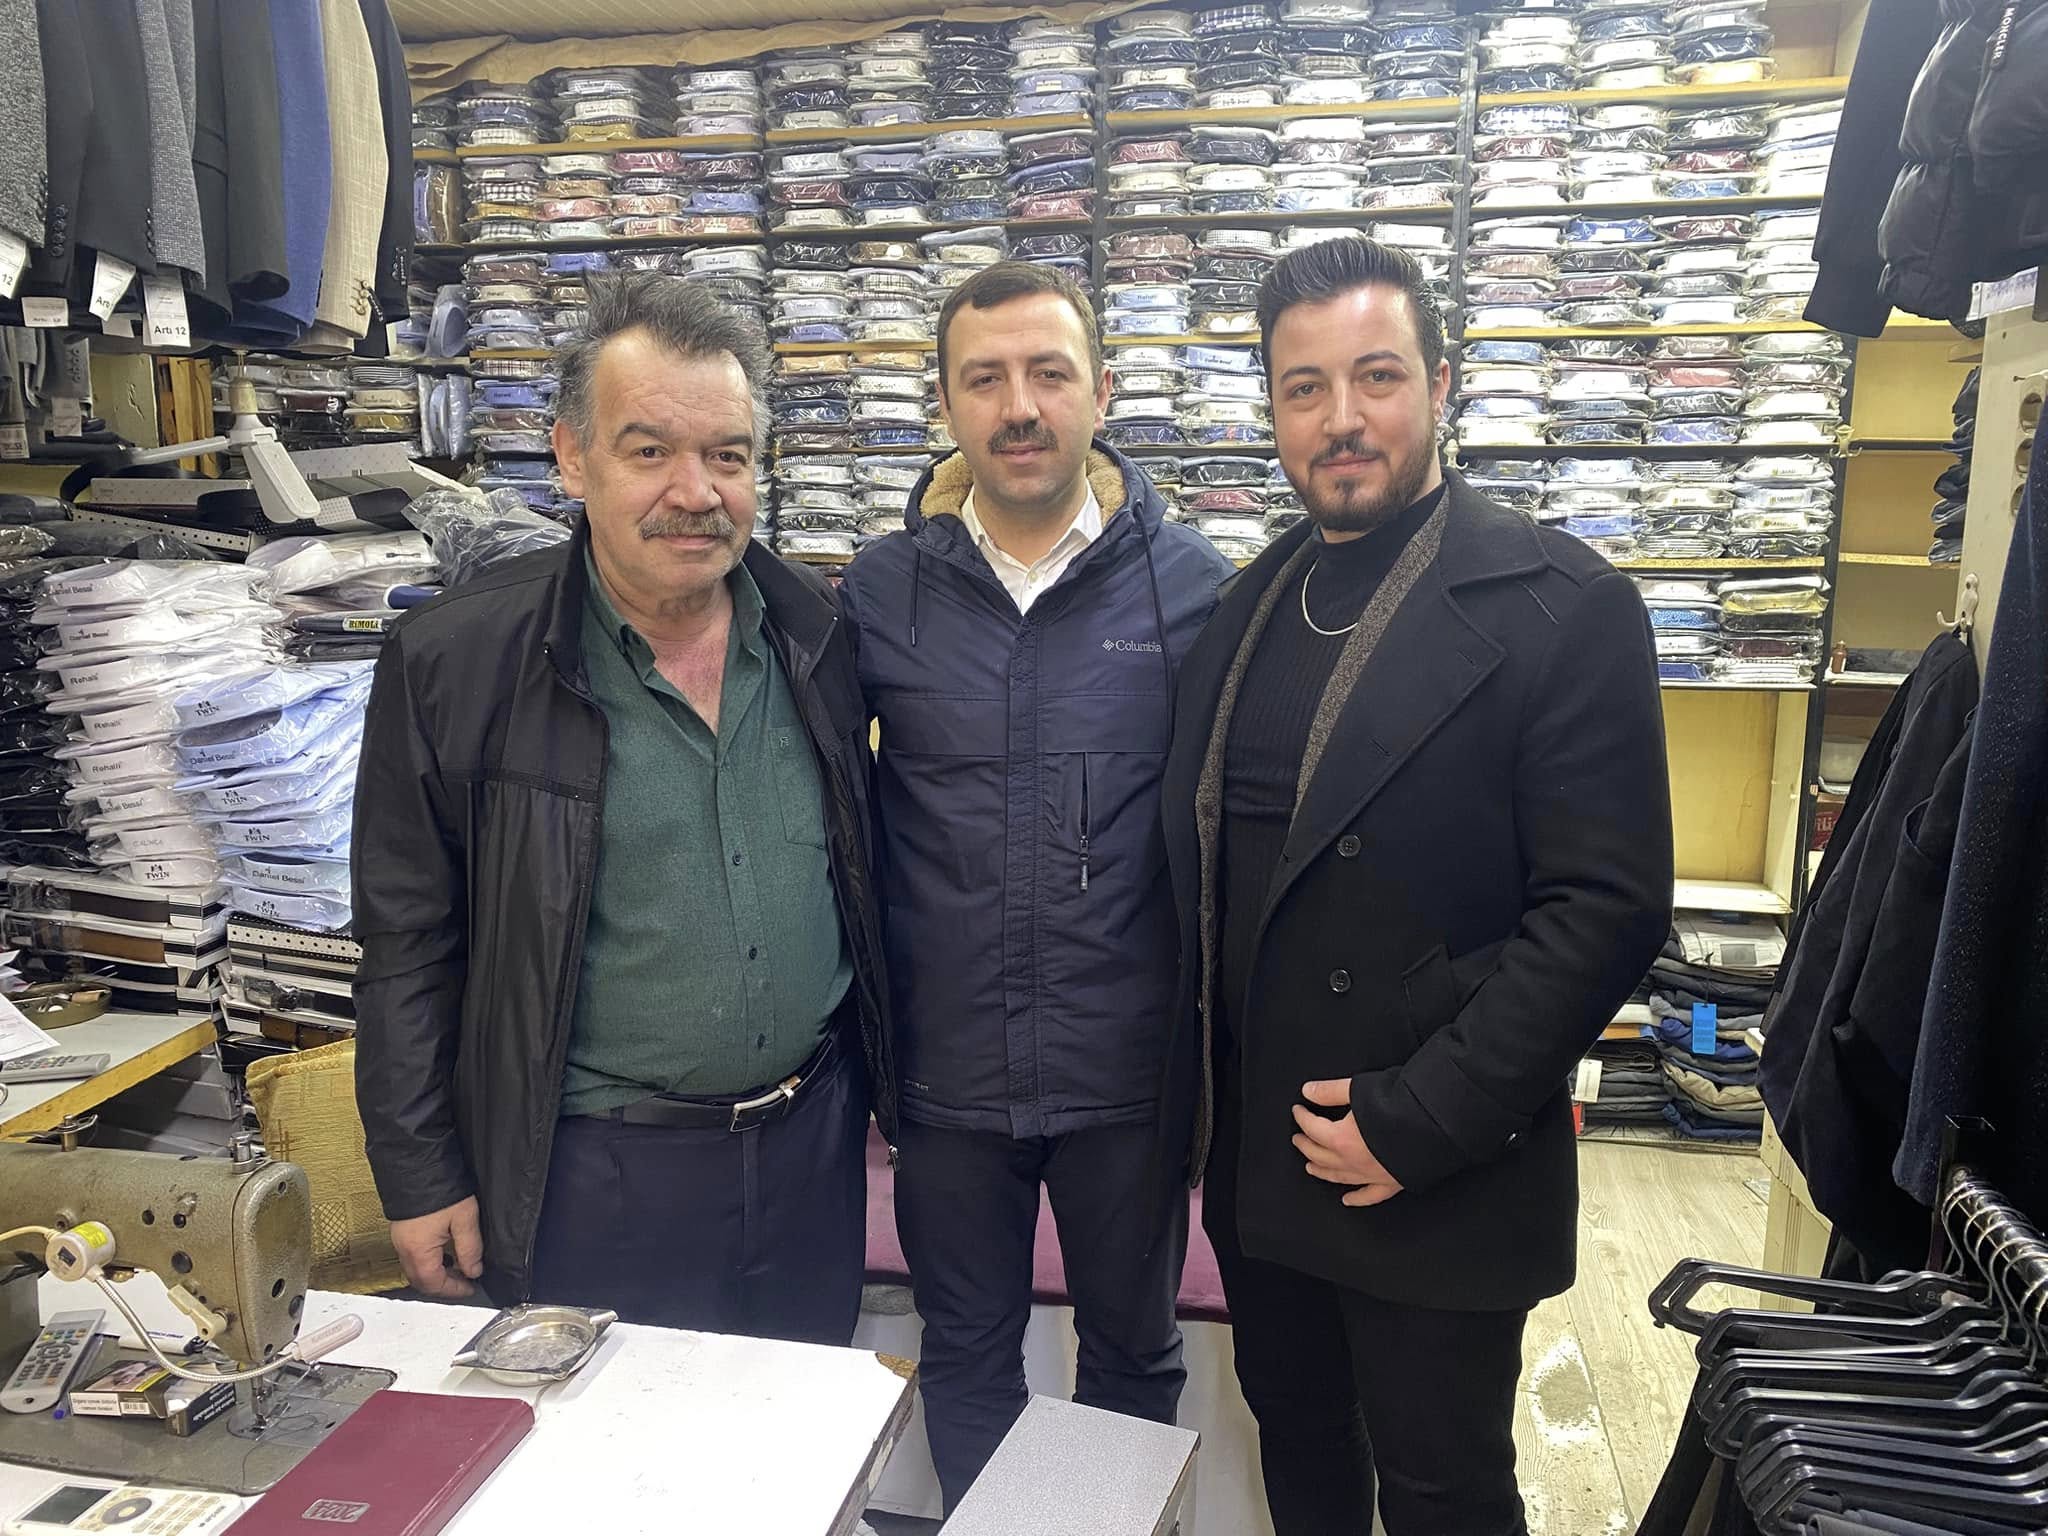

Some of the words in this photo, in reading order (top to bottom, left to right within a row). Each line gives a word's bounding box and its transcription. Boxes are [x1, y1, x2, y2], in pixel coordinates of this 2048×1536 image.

[1993, 7, 2015, 59] MONCLER
[2, 273, 14, 286] 12
[175, 326, 187, 336] 12
[1115, 639, 1162, 653] Columbia
[194, 706, 221, 716] TWIN
[190, 757, 214, 766] Daniel
[215, 753, 236, 763] Bessi
[222, 797, 248, 806] TWIN
[244, 834, 270, 843] TWIN
[145, 870, 171, 880] TWIN
[252, 870, 280, 882] Daniel
[282, 874, 305, 884] Bessi
[255, 903, 281, 918] TWIN
